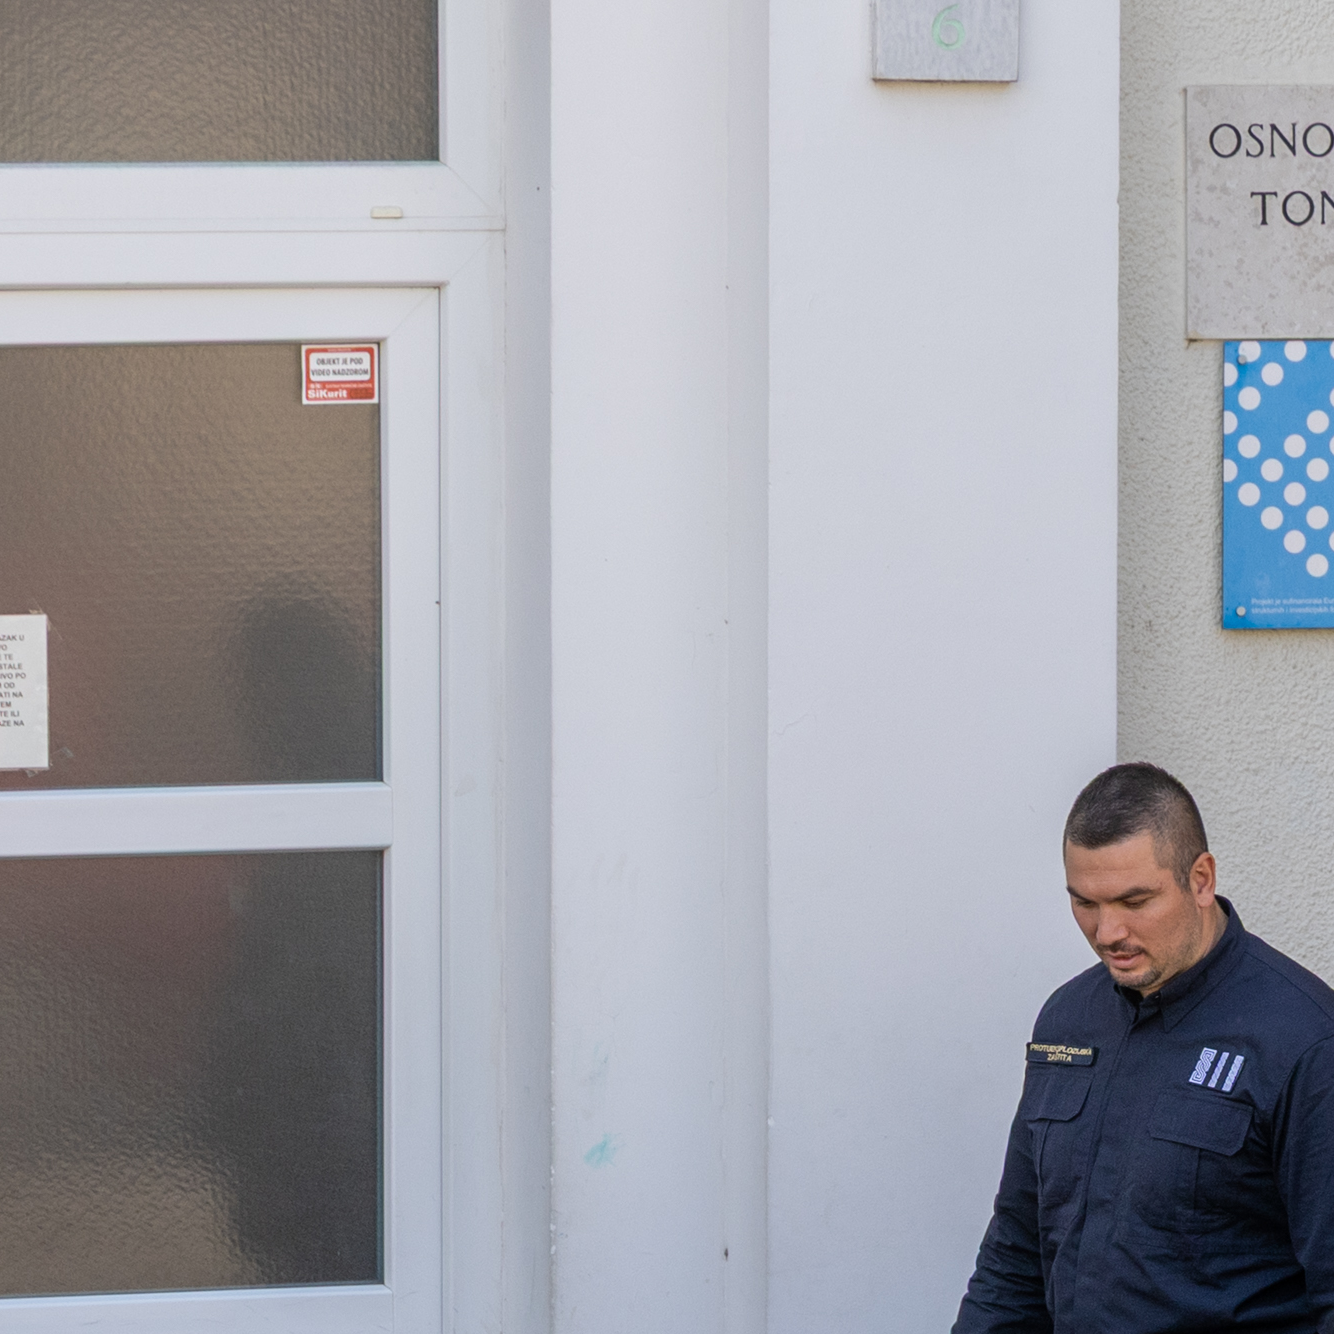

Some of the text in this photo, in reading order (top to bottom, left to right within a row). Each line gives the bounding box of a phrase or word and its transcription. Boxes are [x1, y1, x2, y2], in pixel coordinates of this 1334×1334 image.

[931, 2, 966, 51] 6
[316, 357, 363, 366] OBJEKT JE POD
[311, 368, 369, 376] VIDEO NADZOROM
[308, 388, 347, 399] SiKurit
